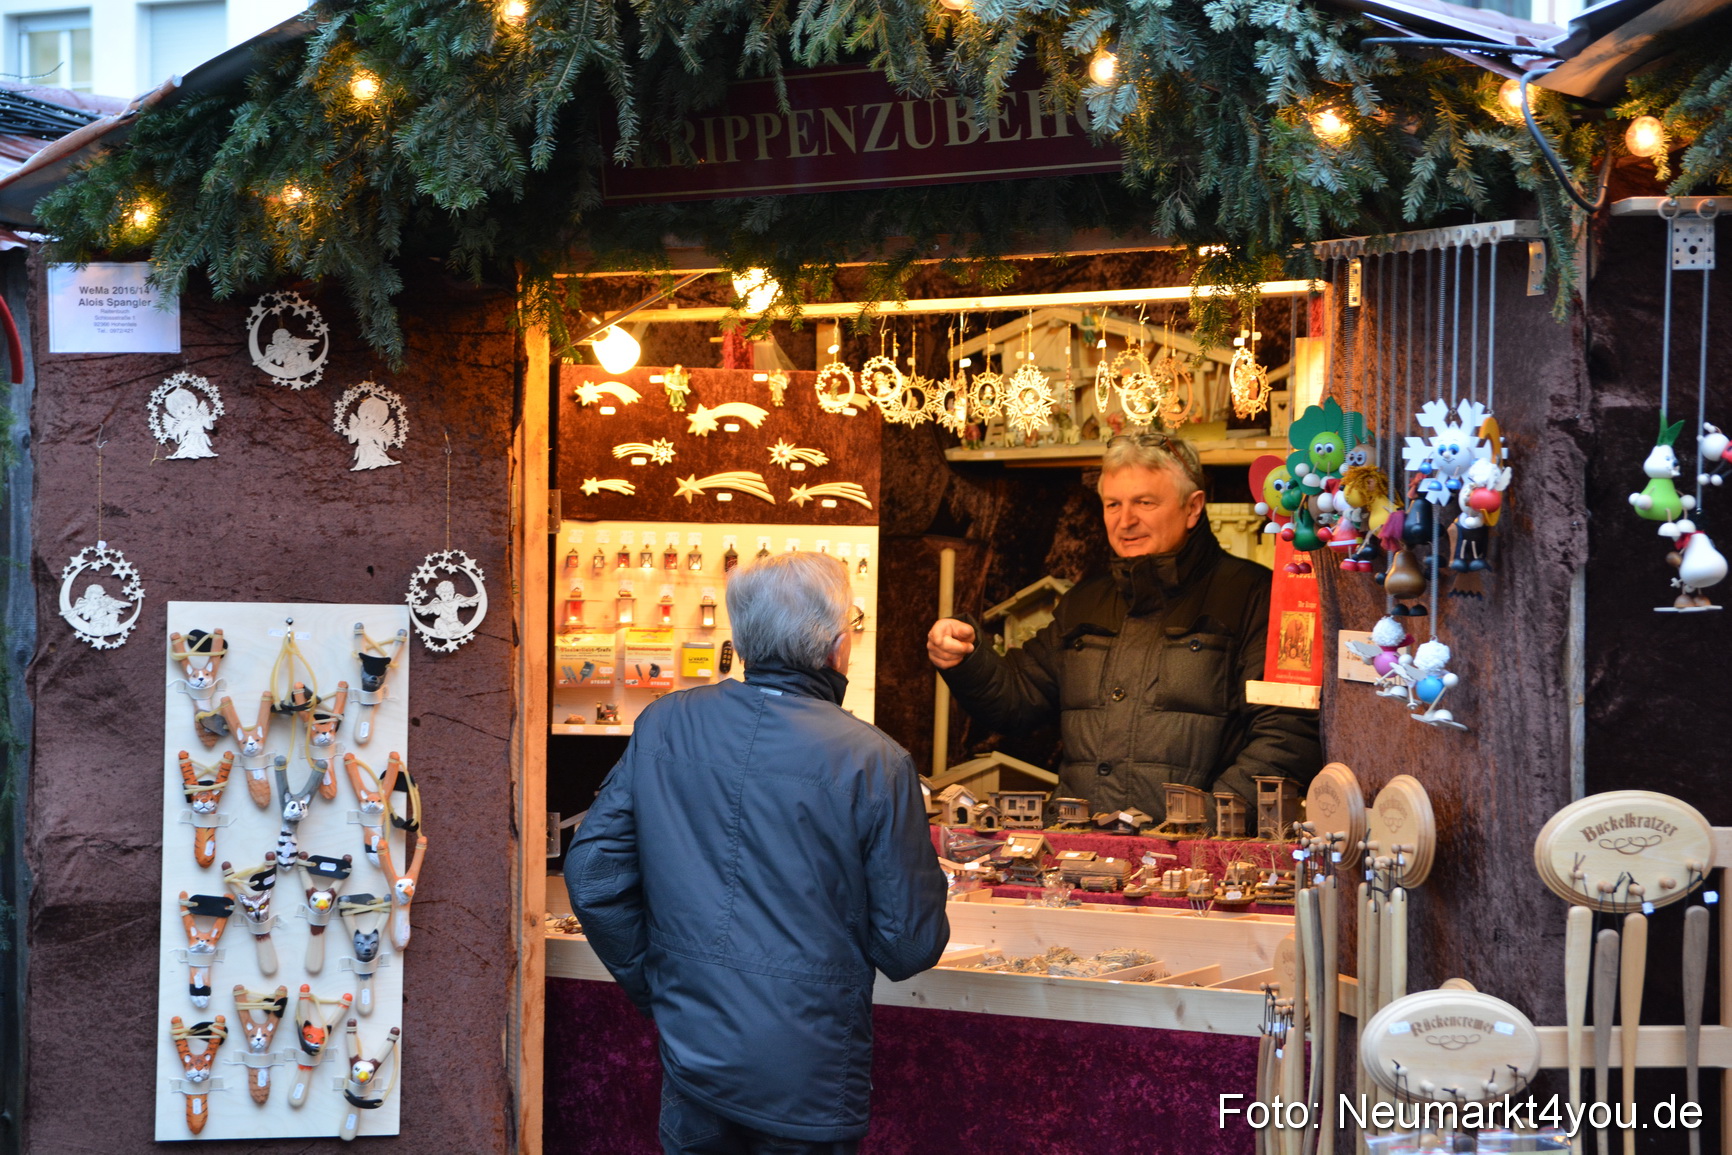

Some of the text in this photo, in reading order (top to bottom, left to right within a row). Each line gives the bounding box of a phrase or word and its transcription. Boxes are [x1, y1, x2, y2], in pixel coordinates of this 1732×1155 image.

[79, 286, 109, 295] WeMa
[78, 298, 151, 308] Alois Spangler
[1579, 812, 1679, 843] Buckelkratzer
